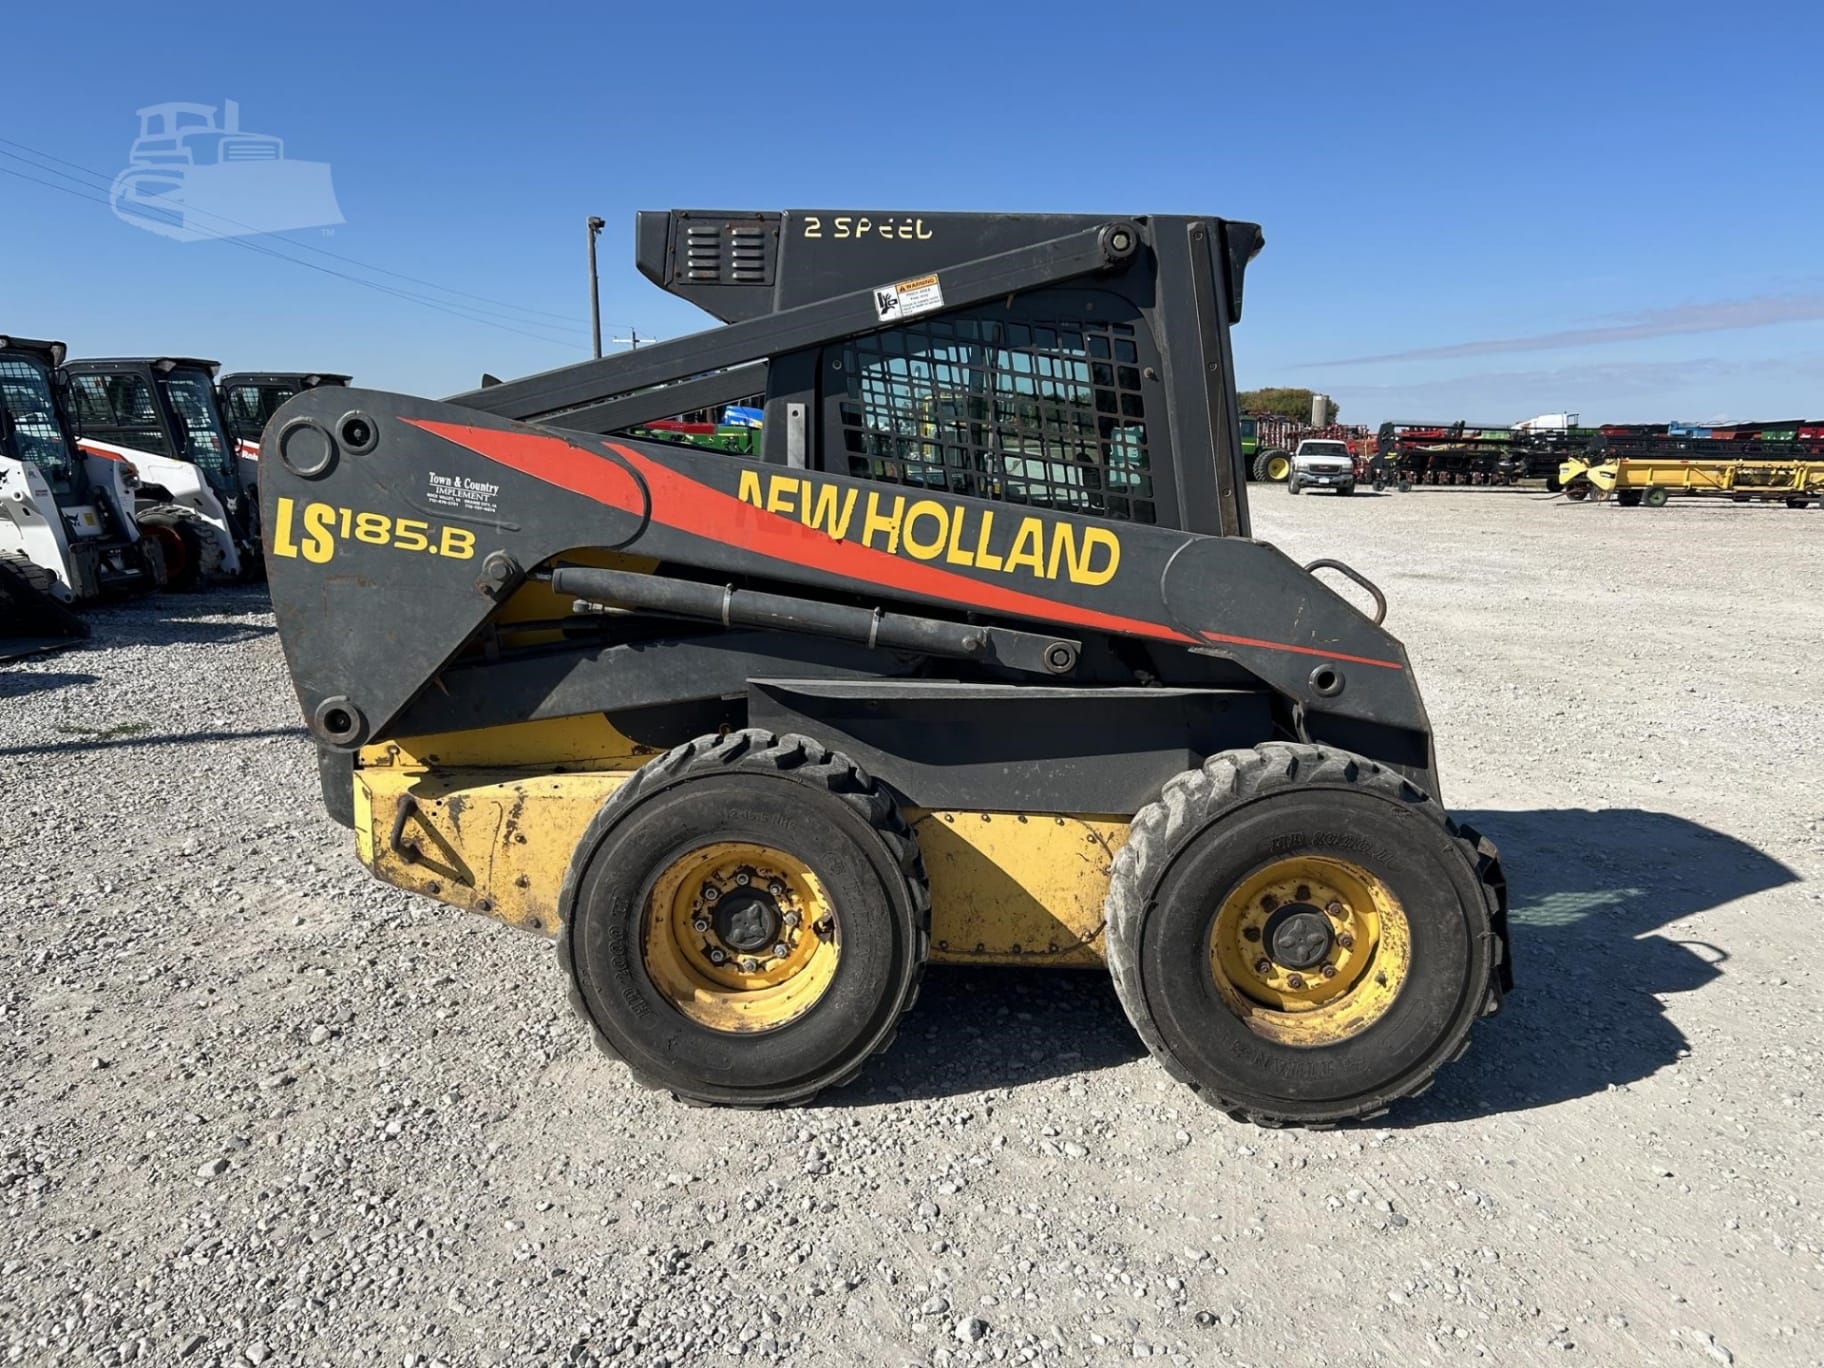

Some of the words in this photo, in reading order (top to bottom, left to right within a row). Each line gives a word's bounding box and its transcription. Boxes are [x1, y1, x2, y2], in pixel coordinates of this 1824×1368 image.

[803, 217, 822, 238] 2
[429, 471, 452, 487] Town
[454, 476, 462, 488] &
[464, 478, 499, 496] Country
[436, 486, 490, 502] IMPLEMENT
[861, 492, 1121, 586] HOLLAND
